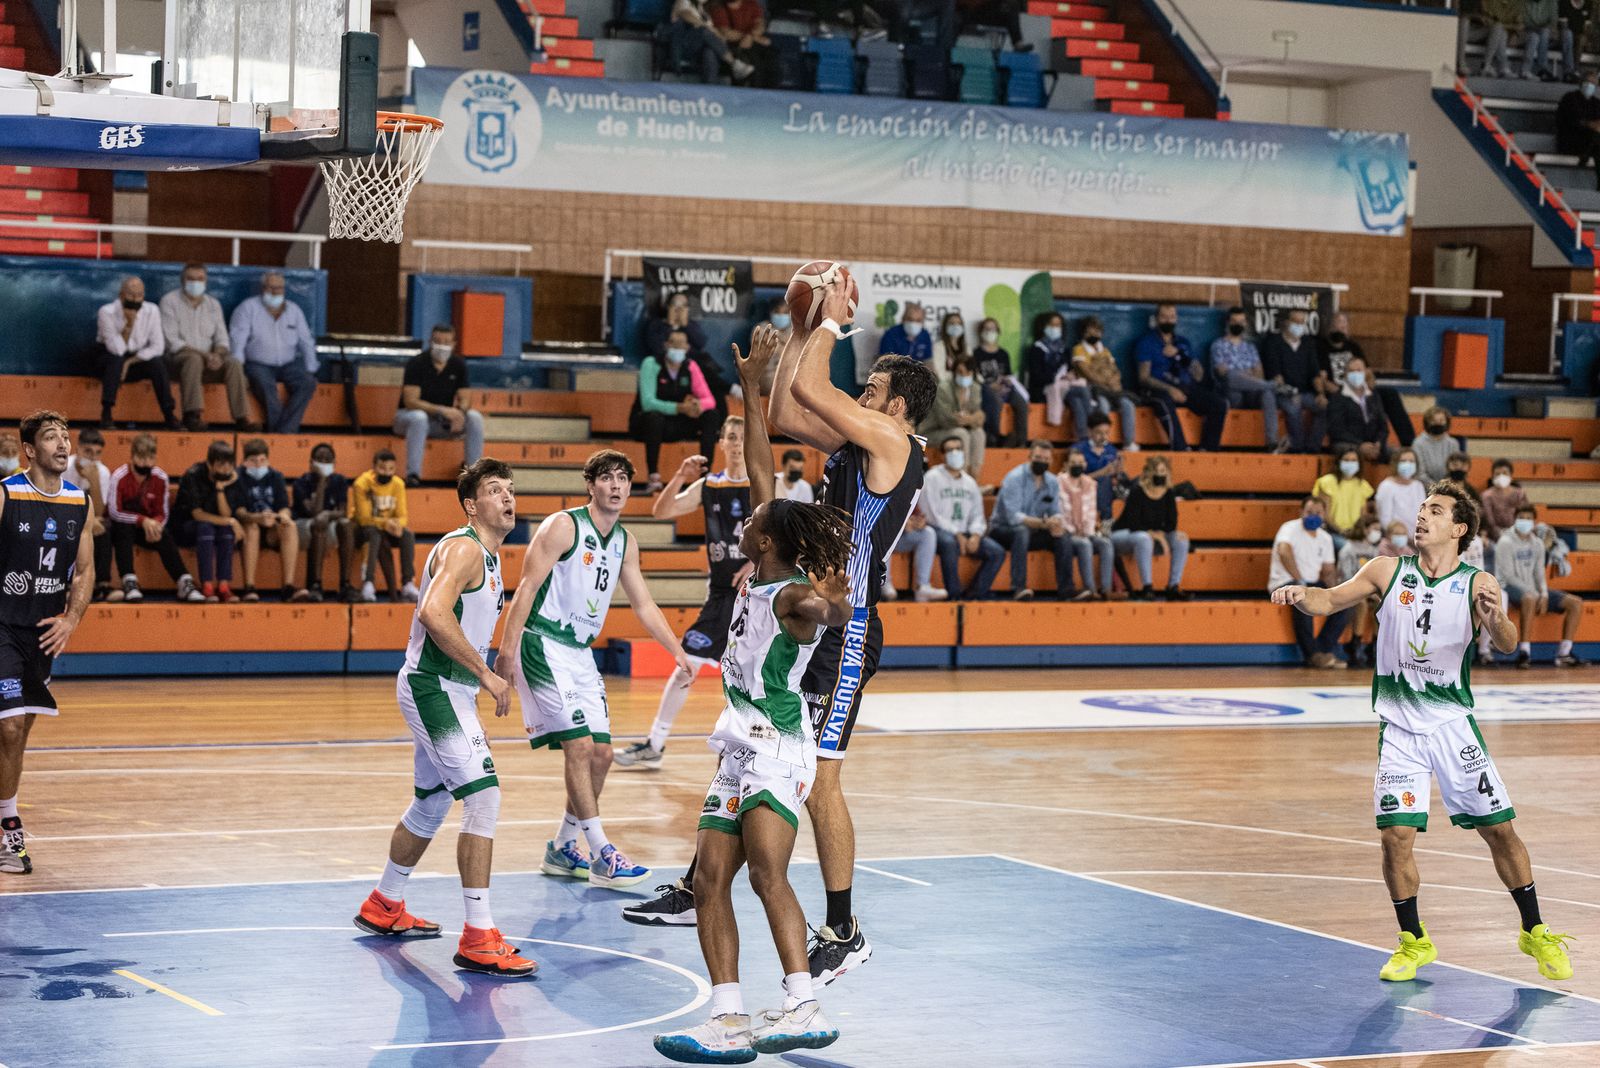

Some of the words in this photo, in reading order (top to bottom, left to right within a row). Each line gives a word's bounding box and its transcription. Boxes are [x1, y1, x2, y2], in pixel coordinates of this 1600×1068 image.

[545, 86, 724, 117] Ayuntamiento
[98, 125, 146, 150] GES
[596, 115, 629, 138] de
[636, 117, 725, 143] Huelva
[783, 102, 829, 133] La
[835, 107, 951, 138] emoción
[959, 109, 991, 140] de
[996, 122, 1084, 152] ganar
[1090, 118, 1147, 159] debe
[1153, 131, 1189, 156] ser
[1194, 137, 1283, 163] mayor
[904, 152, 934, 179] al
[943, 148, 1024, 184] miedo
[1029, 156, 1057, 187] de
[872, 273, 962, 290] ASPROMIN
[700, 286, 738, 313] ORO
[1254, 308, 1281, 334] DE
[39, 546, 57, 571] 14
[594, 567, 610, 592] 13
[1416, 608, 1432, 635] 4
[1398, 659, 1445, 677] Extremadura
[822, 674, 859, 742] HUELVA
[1462, 757, 1487, 770] TOYOTA
[1477, 771, 1494, 798] 4
